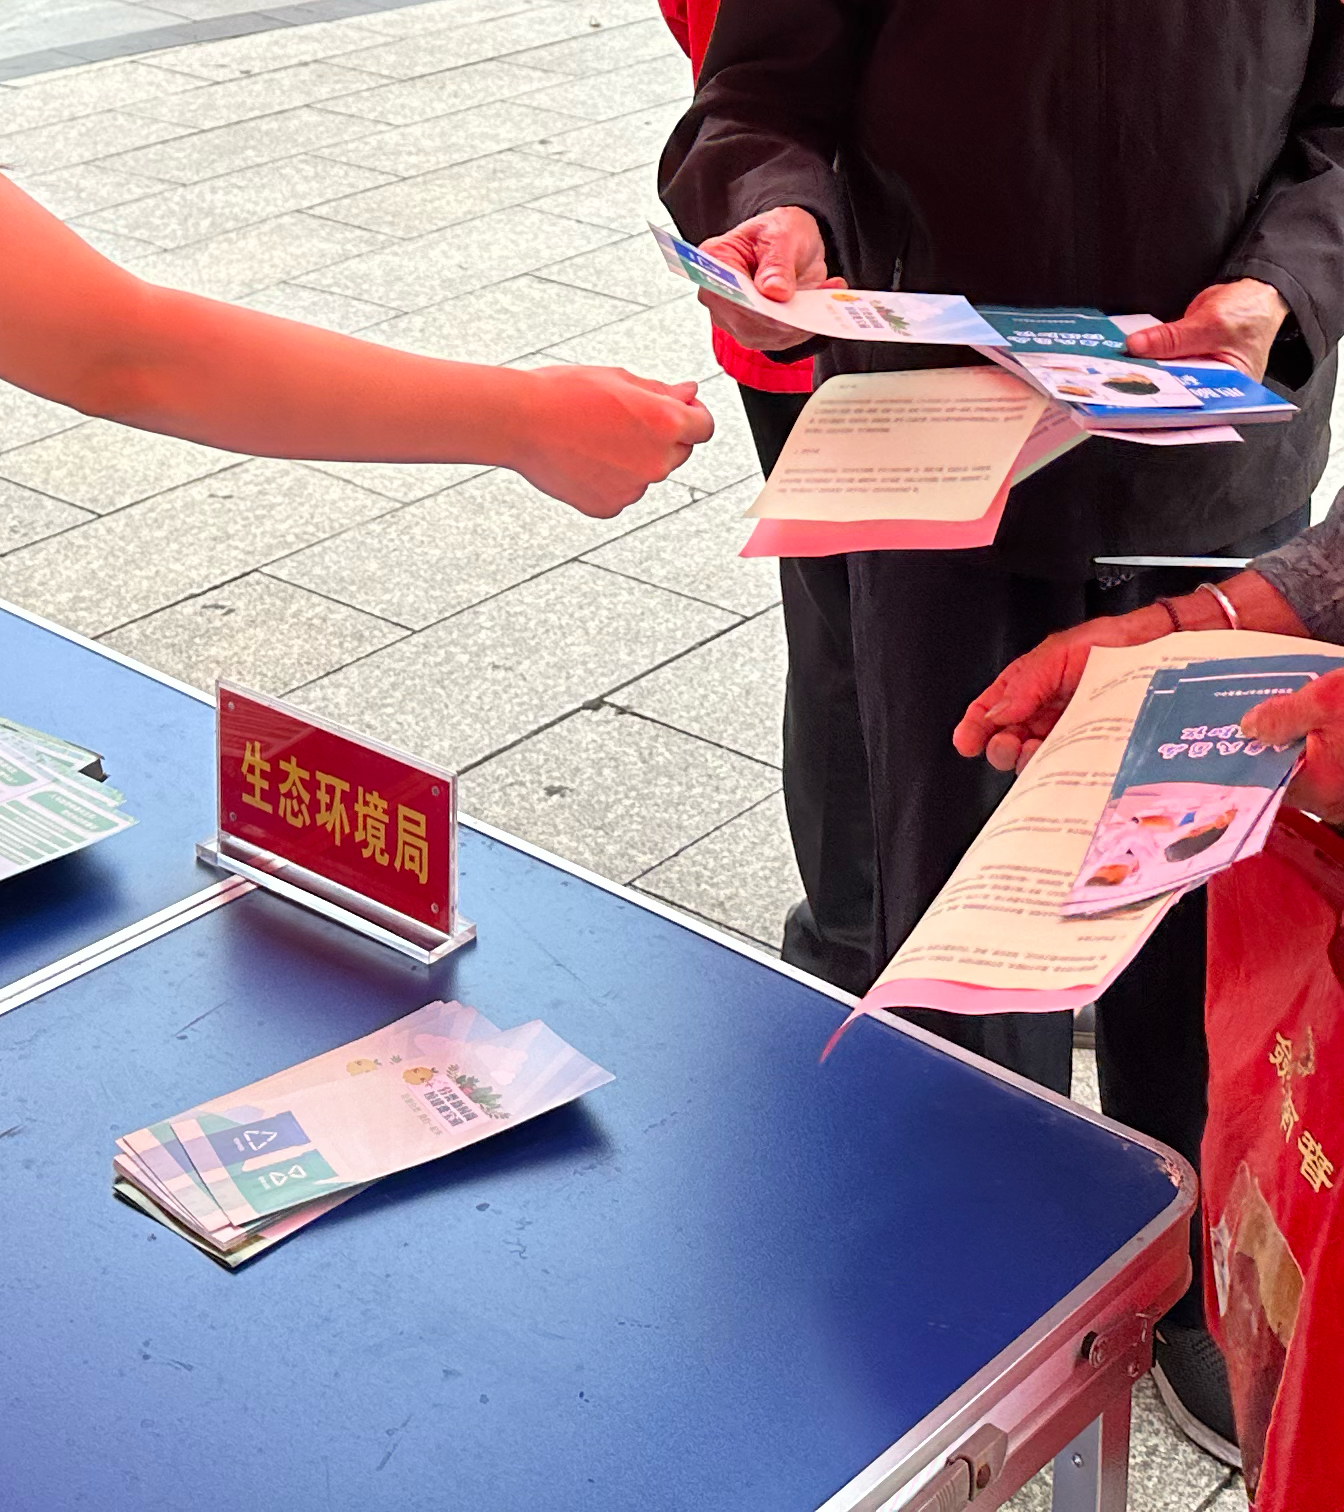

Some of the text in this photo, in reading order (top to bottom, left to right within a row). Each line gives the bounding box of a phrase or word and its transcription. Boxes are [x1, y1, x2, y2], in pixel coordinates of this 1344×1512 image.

[241, 740, 429, 885] 生态环境局
